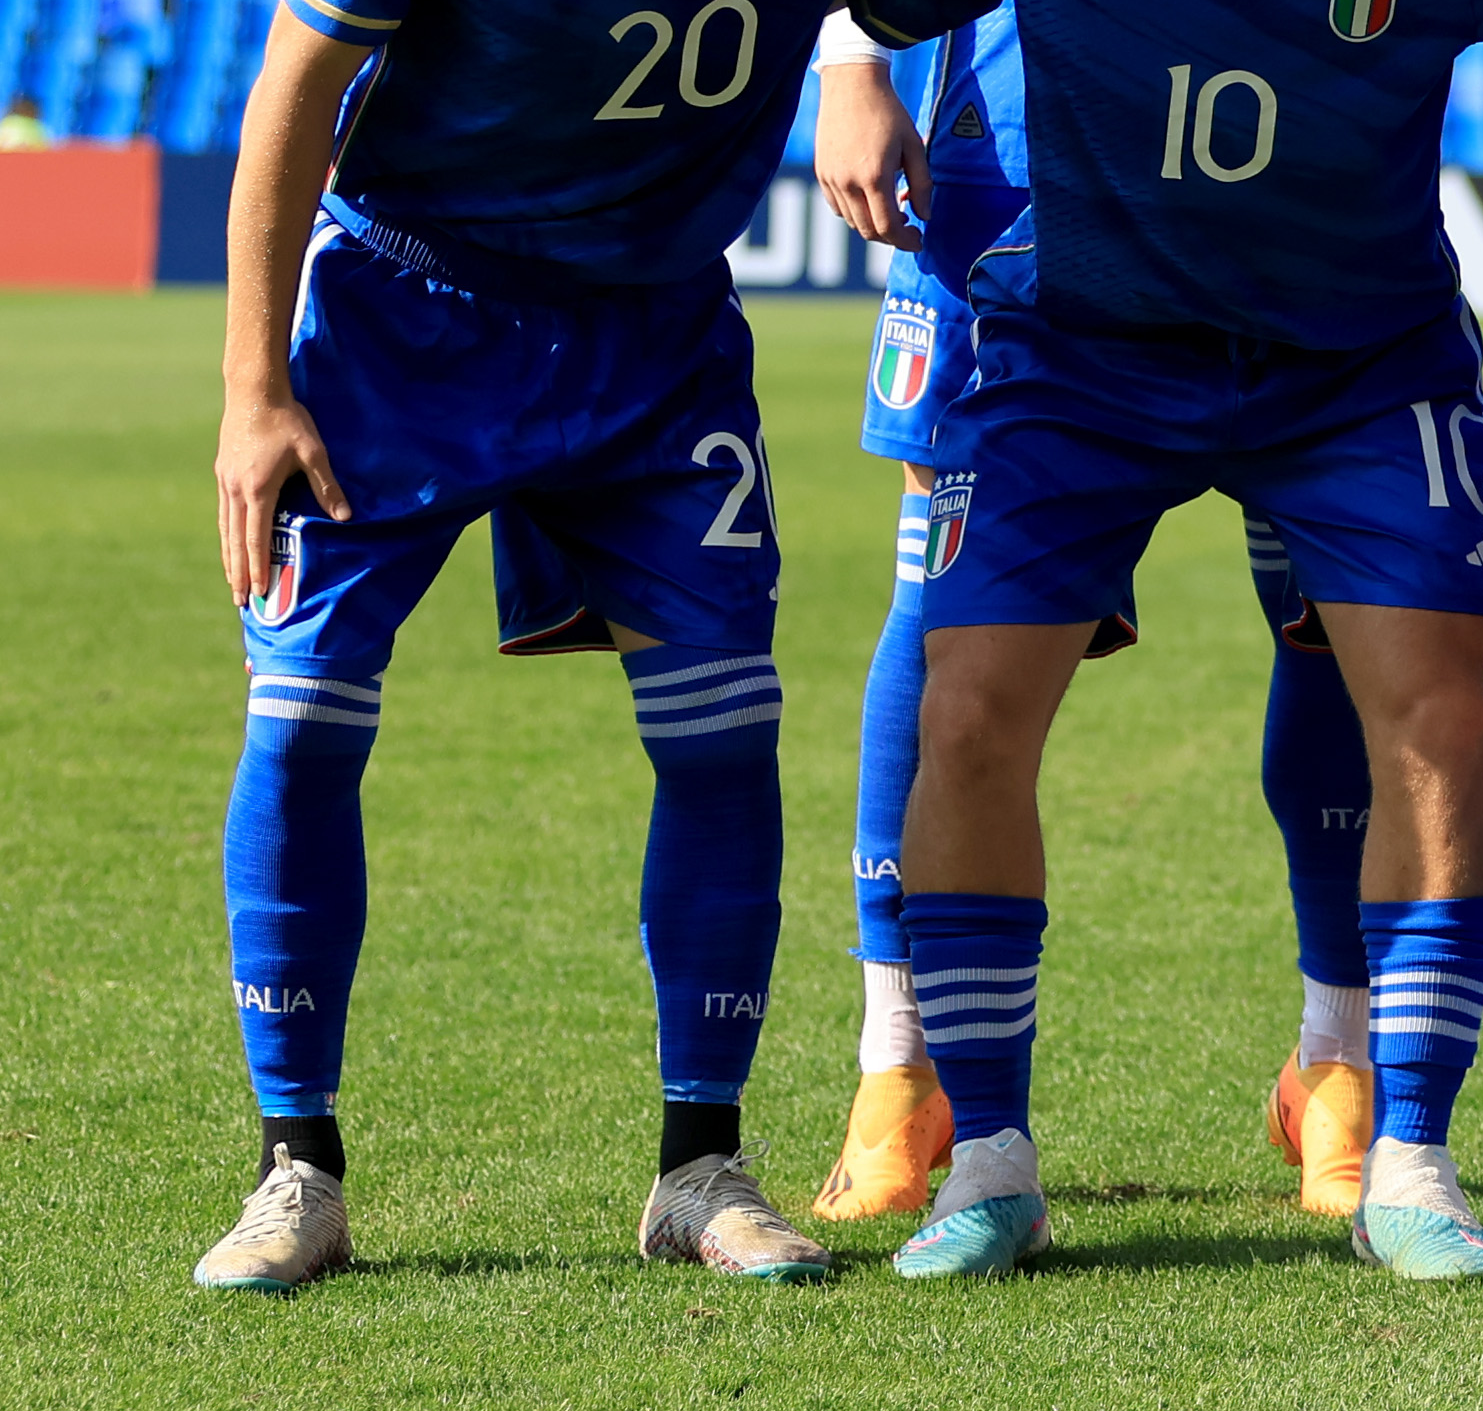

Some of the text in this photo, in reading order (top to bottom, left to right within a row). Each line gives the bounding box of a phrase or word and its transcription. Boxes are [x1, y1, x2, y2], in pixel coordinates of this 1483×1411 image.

[1160, 64, 1278, 182] 10
[886, 320, 928, 348] ITALIA
[932, 493, 966, 517] ITALIA
